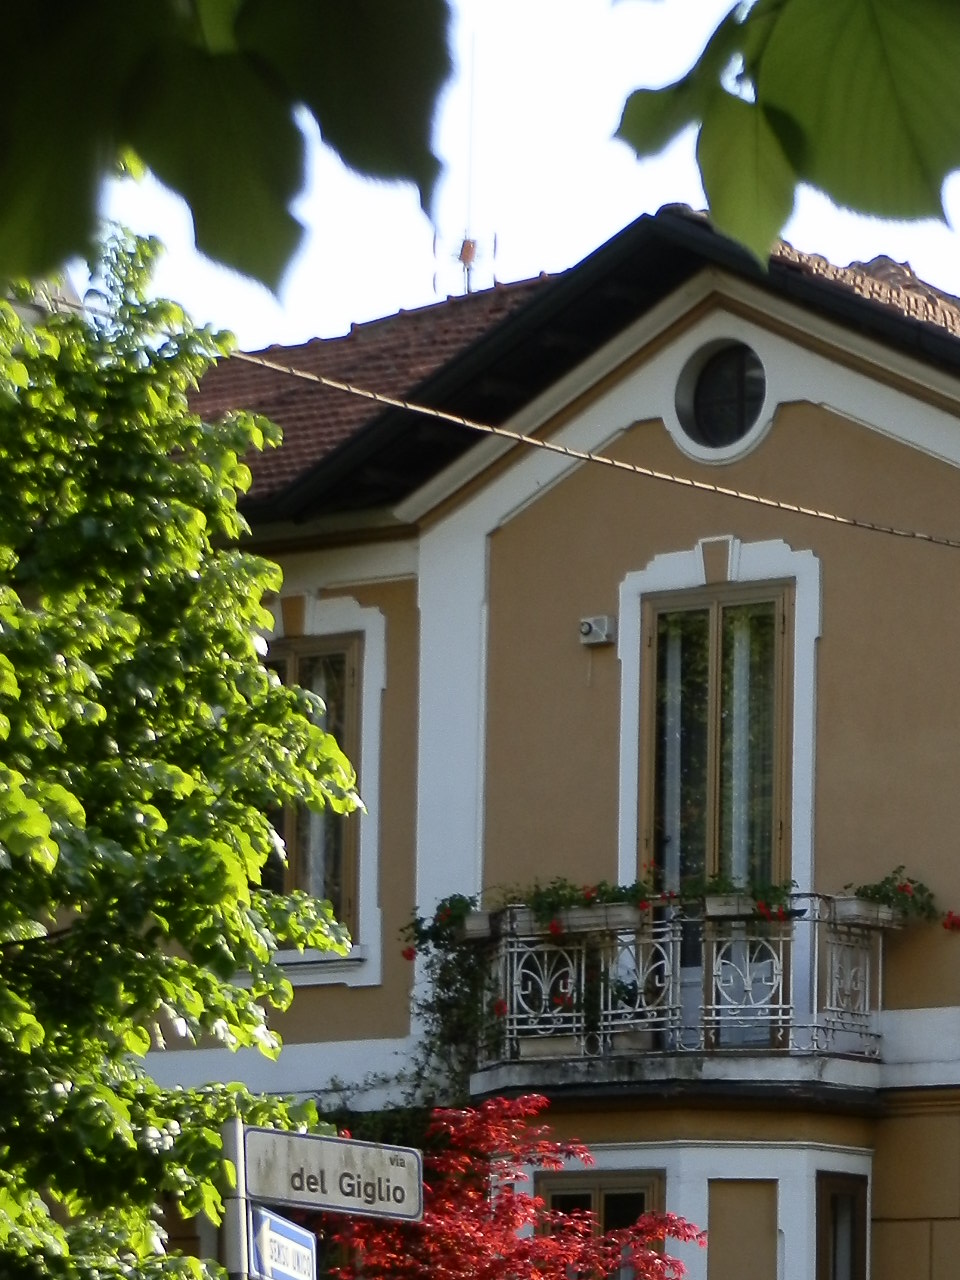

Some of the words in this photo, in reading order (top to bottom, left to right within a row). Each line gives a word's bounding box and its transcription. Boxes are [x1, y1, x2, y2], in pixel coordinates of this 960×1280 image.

[389, 1155, 406, 1168] via
[290, 1167, 328, 1195] del
[338, 1171, 406, 1205] Giglio
[269, 1238, 289, 1269] SENSO
[291, 1248, 311, 1278] UNICO
